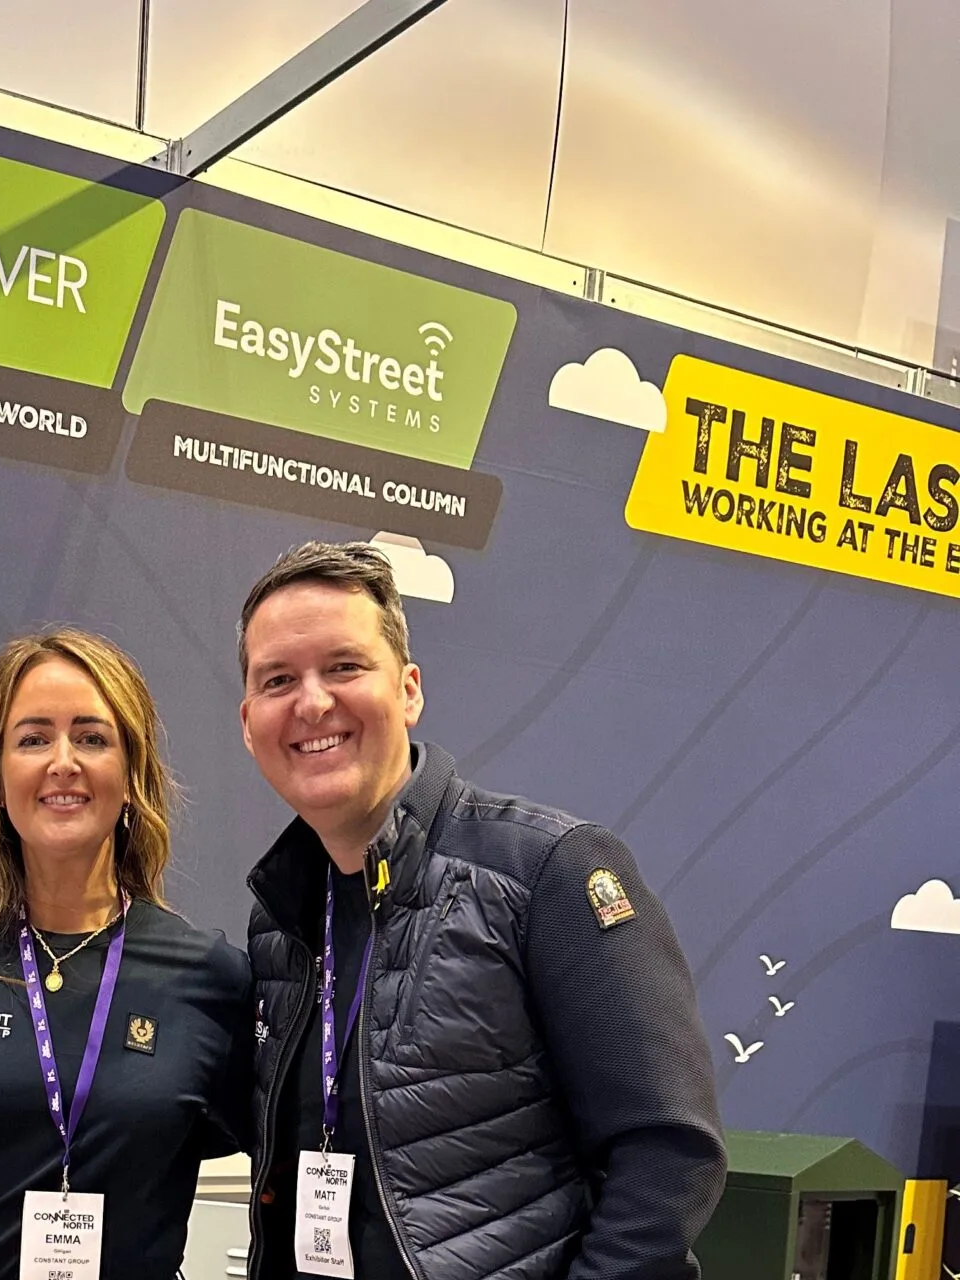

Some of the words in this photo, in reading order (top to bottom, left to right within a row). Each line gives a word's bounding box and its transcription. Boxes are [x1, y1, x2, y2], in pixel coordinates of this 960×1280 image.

[214, 299, 445, 401] EasyStreet
[309, 385, 441, 433] SYSTEMS
[685, 397, 817, 499] THE
[838, 439, 960, 533] LAS
[173, 435, 376, 499] MULTIFUNCTIONAL
[382, 481, 466, 517] COLUMN
[681, 480, 828, 543] WORKING
[836, 519, 874, 553] AT
[884, 528, 937, 568] THE
[306, 1166, 348, 1178] CONNECTED
[326, 1177, 348, 1186] NORTH
[314, 1189, 336, 1201] MATT
[33, 1211, 94, 1223] CONNECTED
[63, 1222, 94, 1230] NORTH
[45, 1234, 81, 1245] EMMA
